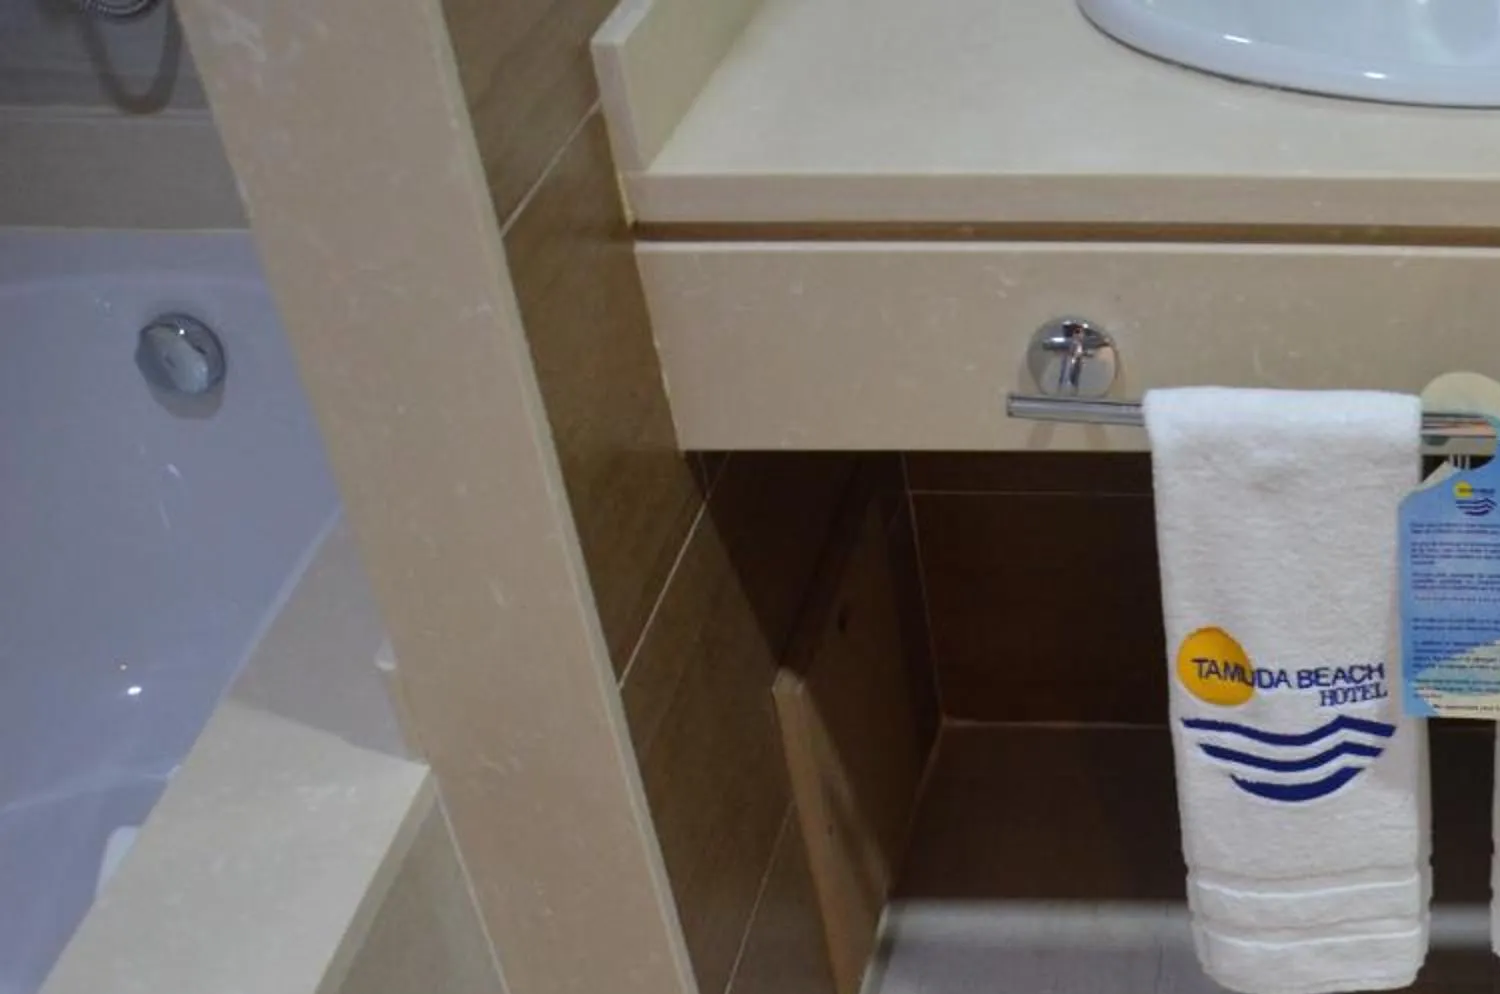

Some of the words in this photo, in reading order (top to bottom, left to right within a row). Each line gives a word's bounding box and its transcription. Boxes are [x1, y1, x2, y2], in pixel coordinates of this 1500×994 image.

[1191, 657, 1292, 690] TAMUDA
[1296, 662, 1386, 690] BEACH
[1319, 682, 1388, 707] HOTEL
